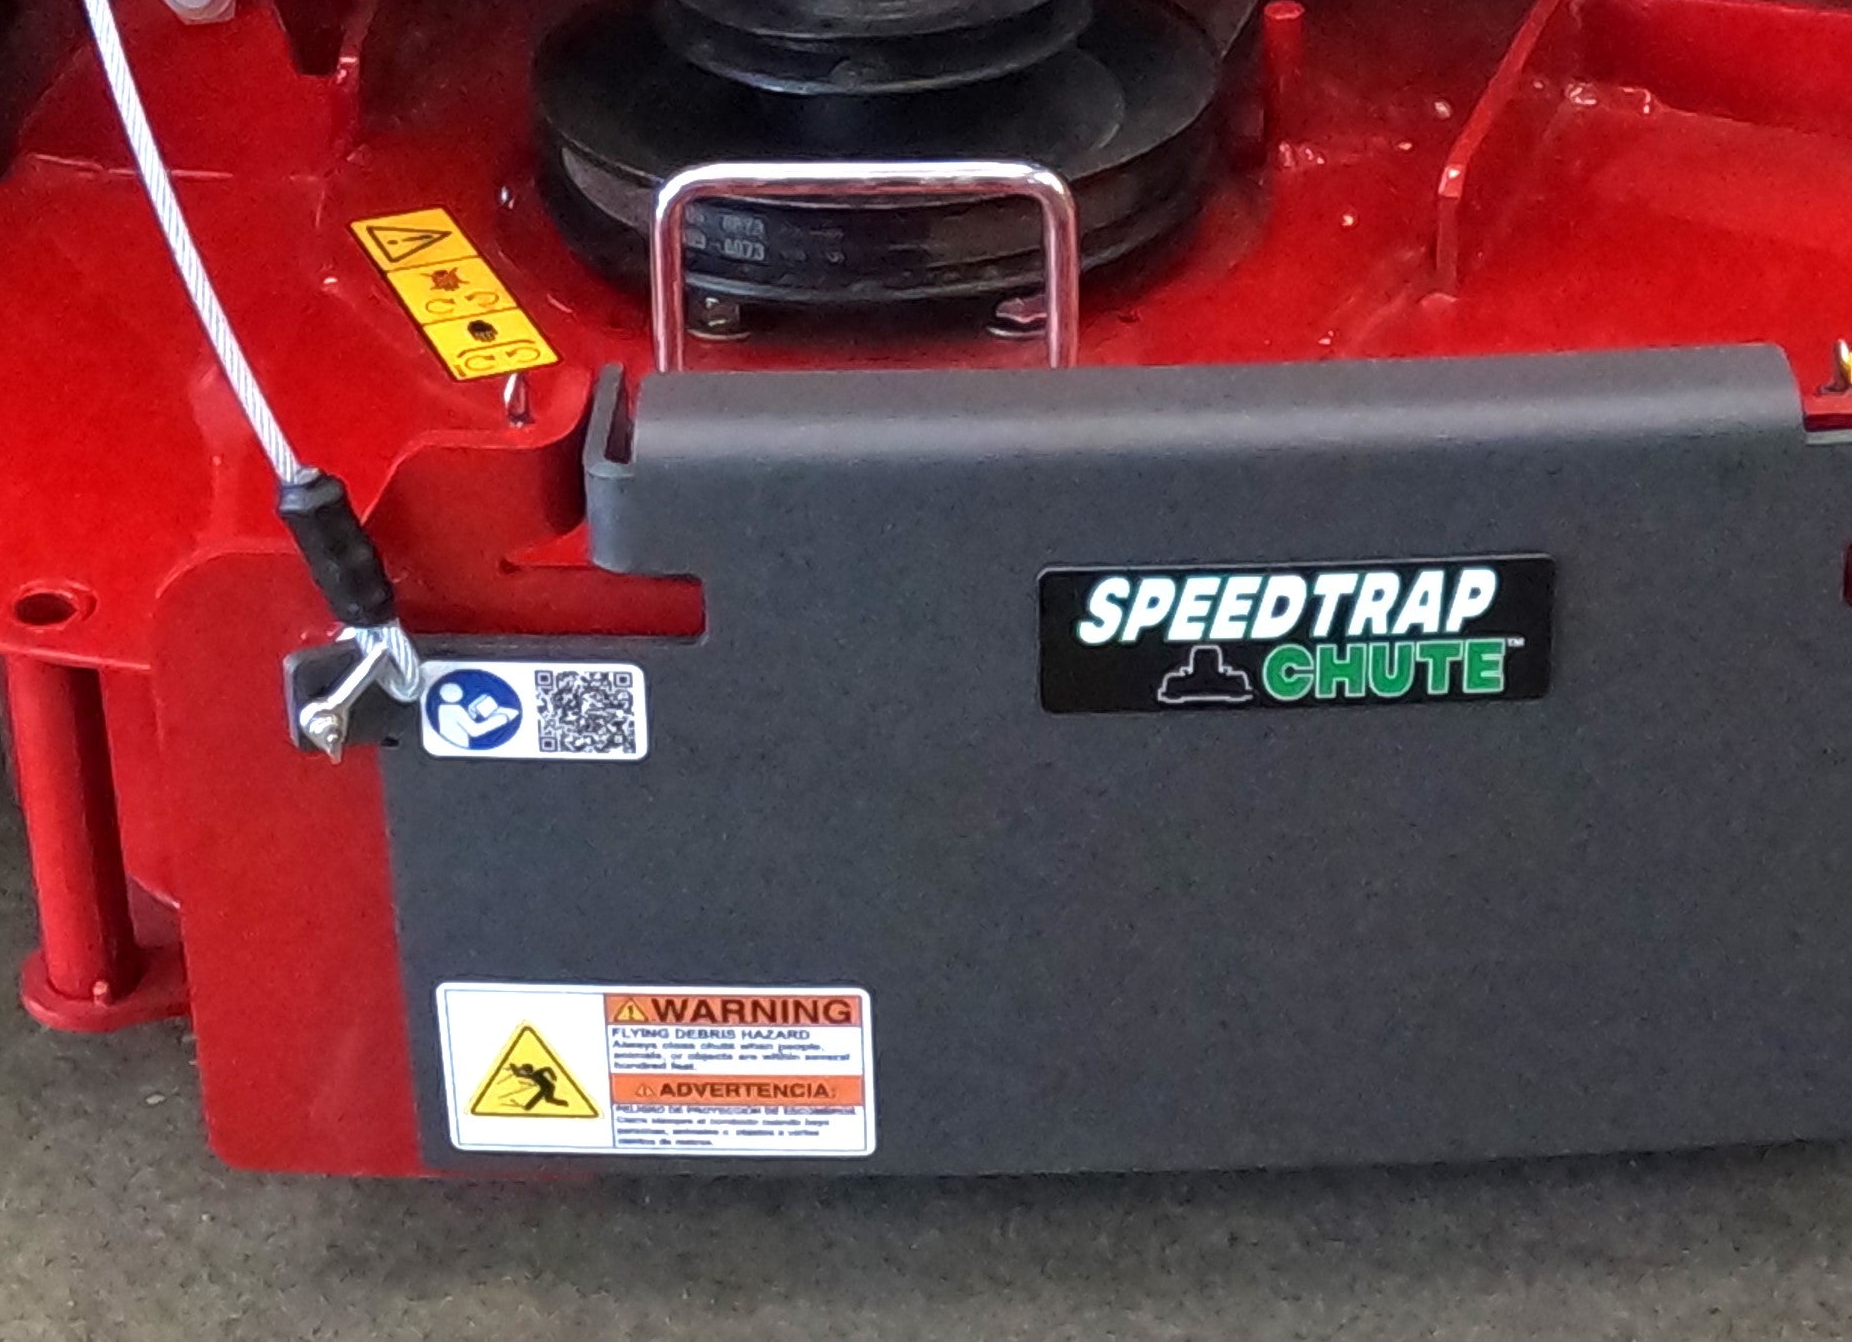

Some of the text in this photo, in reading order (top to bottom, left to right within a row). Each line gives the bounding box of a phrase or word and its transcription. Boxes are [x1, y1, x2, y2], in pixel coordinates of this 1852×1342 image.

[1077, 565, 1500, 646] SPEEDTRAP
[651, 996, 853, 1026] WARNING
[611, 1027, 811, 1041] FLYING DEBRIS HAZARD
